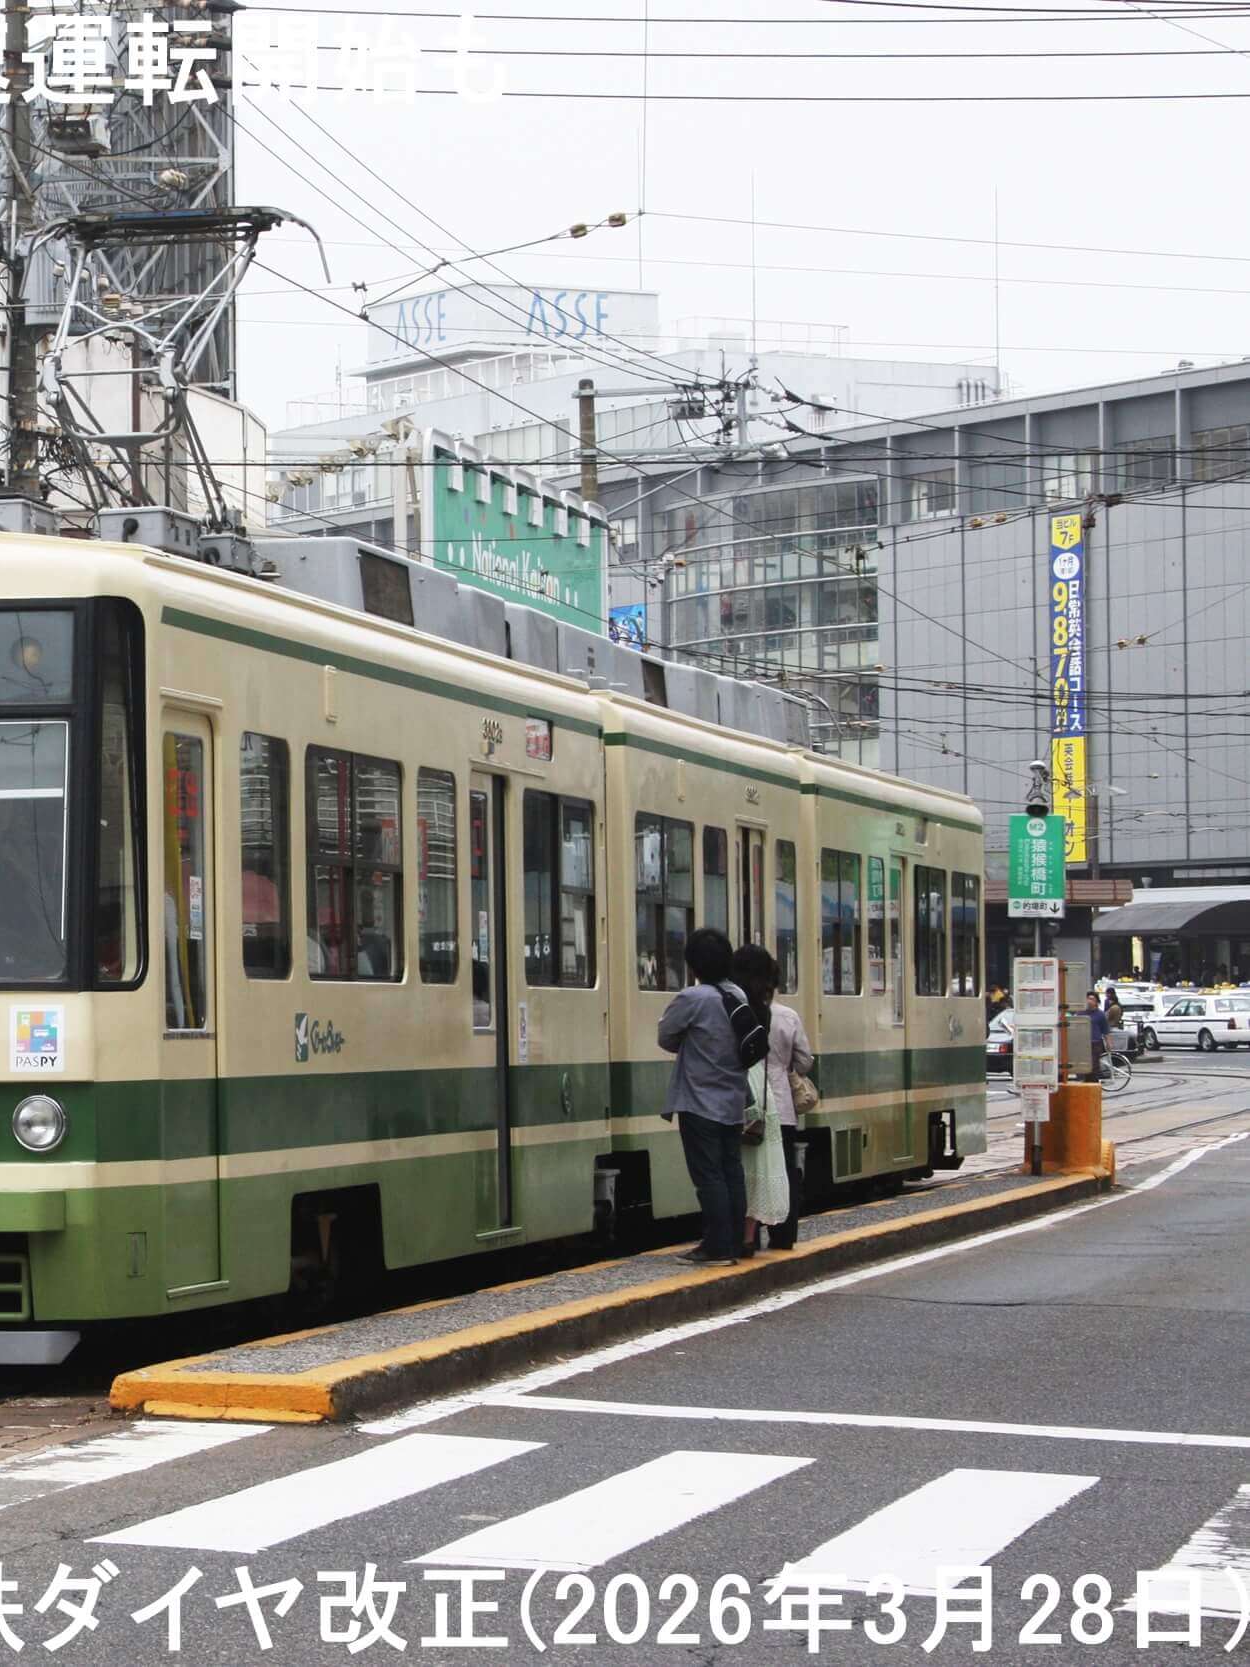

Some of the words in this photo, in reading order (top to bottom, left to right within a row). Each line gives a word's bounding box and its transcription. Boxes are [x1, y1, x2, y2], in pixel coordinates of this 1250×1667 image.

[394, 293, 447, 351] ASSE
[526, 289, 609, 341] ASSE
[472, 530, 519, 594] National
[1059, 531, 1075, 545] 7F
[1068, 580, 1083, 731] 日常英会話コース
[15, 1055, 58, 1068] PASPY
